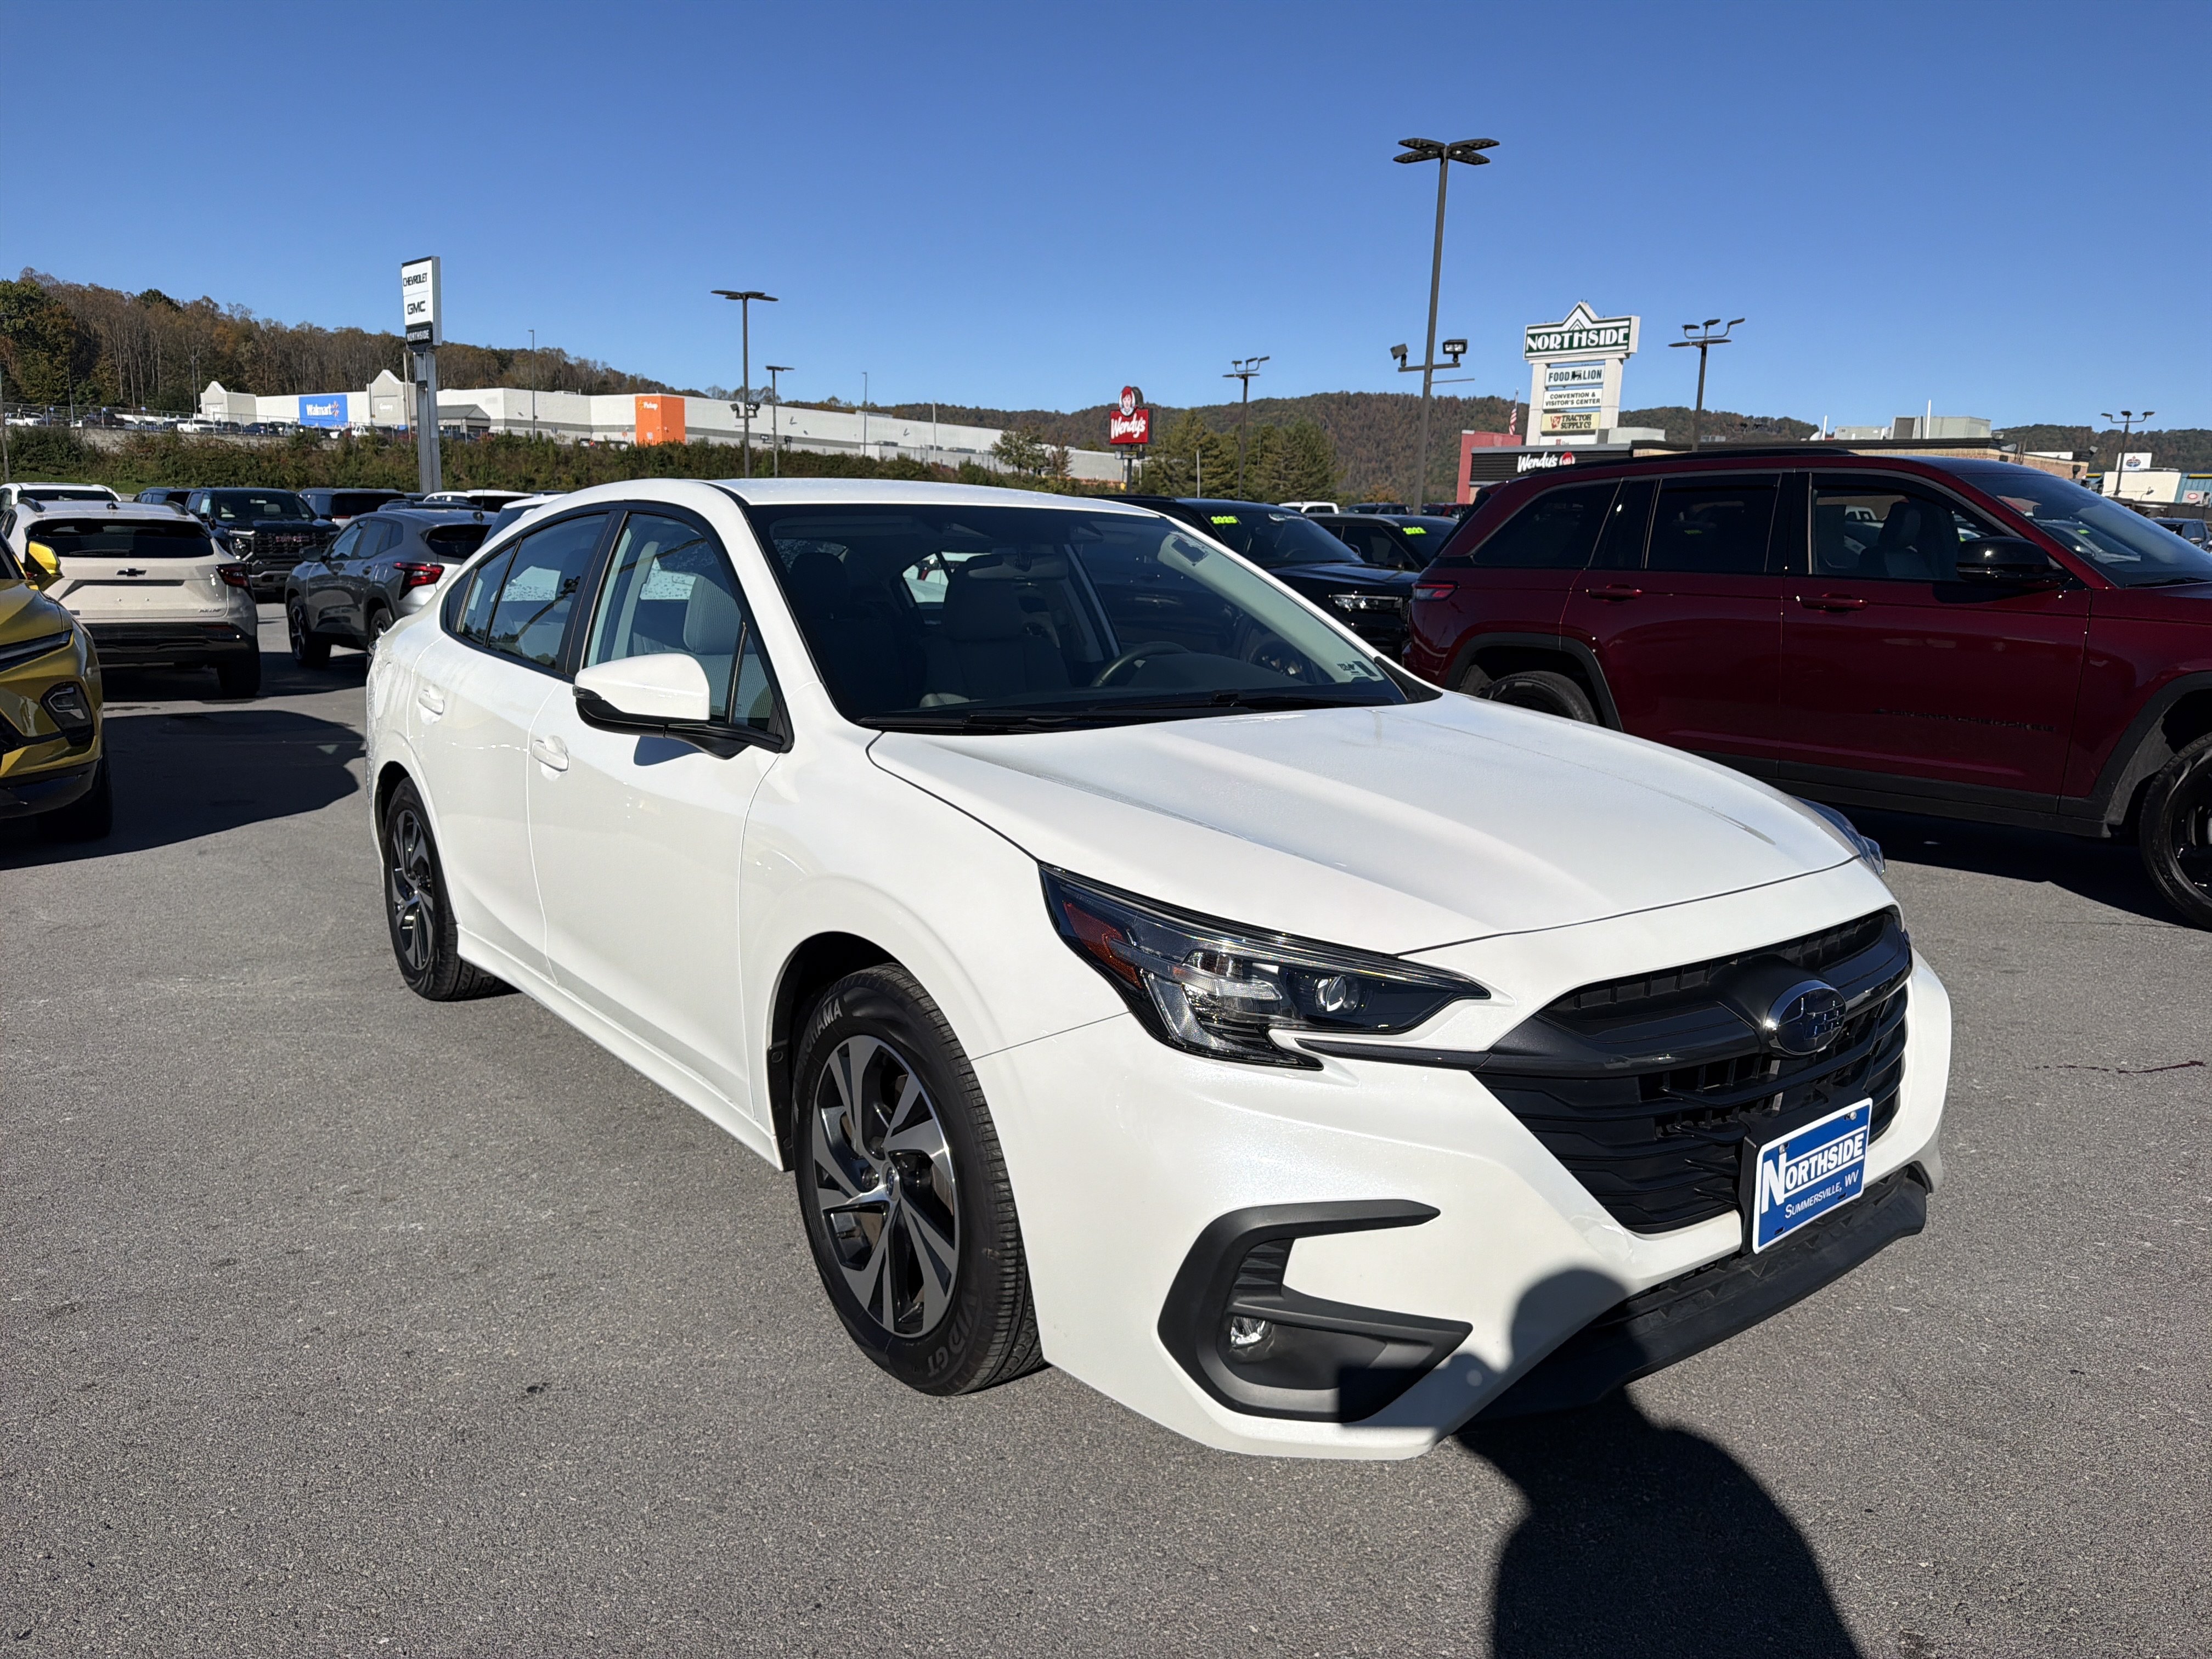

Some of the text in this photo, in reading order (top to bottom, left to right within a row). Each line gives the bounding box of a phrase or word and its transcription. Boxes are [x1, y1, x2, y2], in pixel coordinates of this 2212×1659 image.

[403, 273, 427, 286] CHEVROLET
[407, 301, 426, 315] GMC
[407, 329, 430, 342] NORTHSIDE
[1526, 328, 1629, 351] NORTHSIDE
[1548, 369, 1602, 382] FOOD LION
[1110, 413, 1146, 439] Wendy's
[1210, 516, 1238, 524] 2025
[1761, 1132, 1864, 1214] NORTHSIDE
[1785, 1169, 1859, 1219] SUMMERSVILLE, WV
